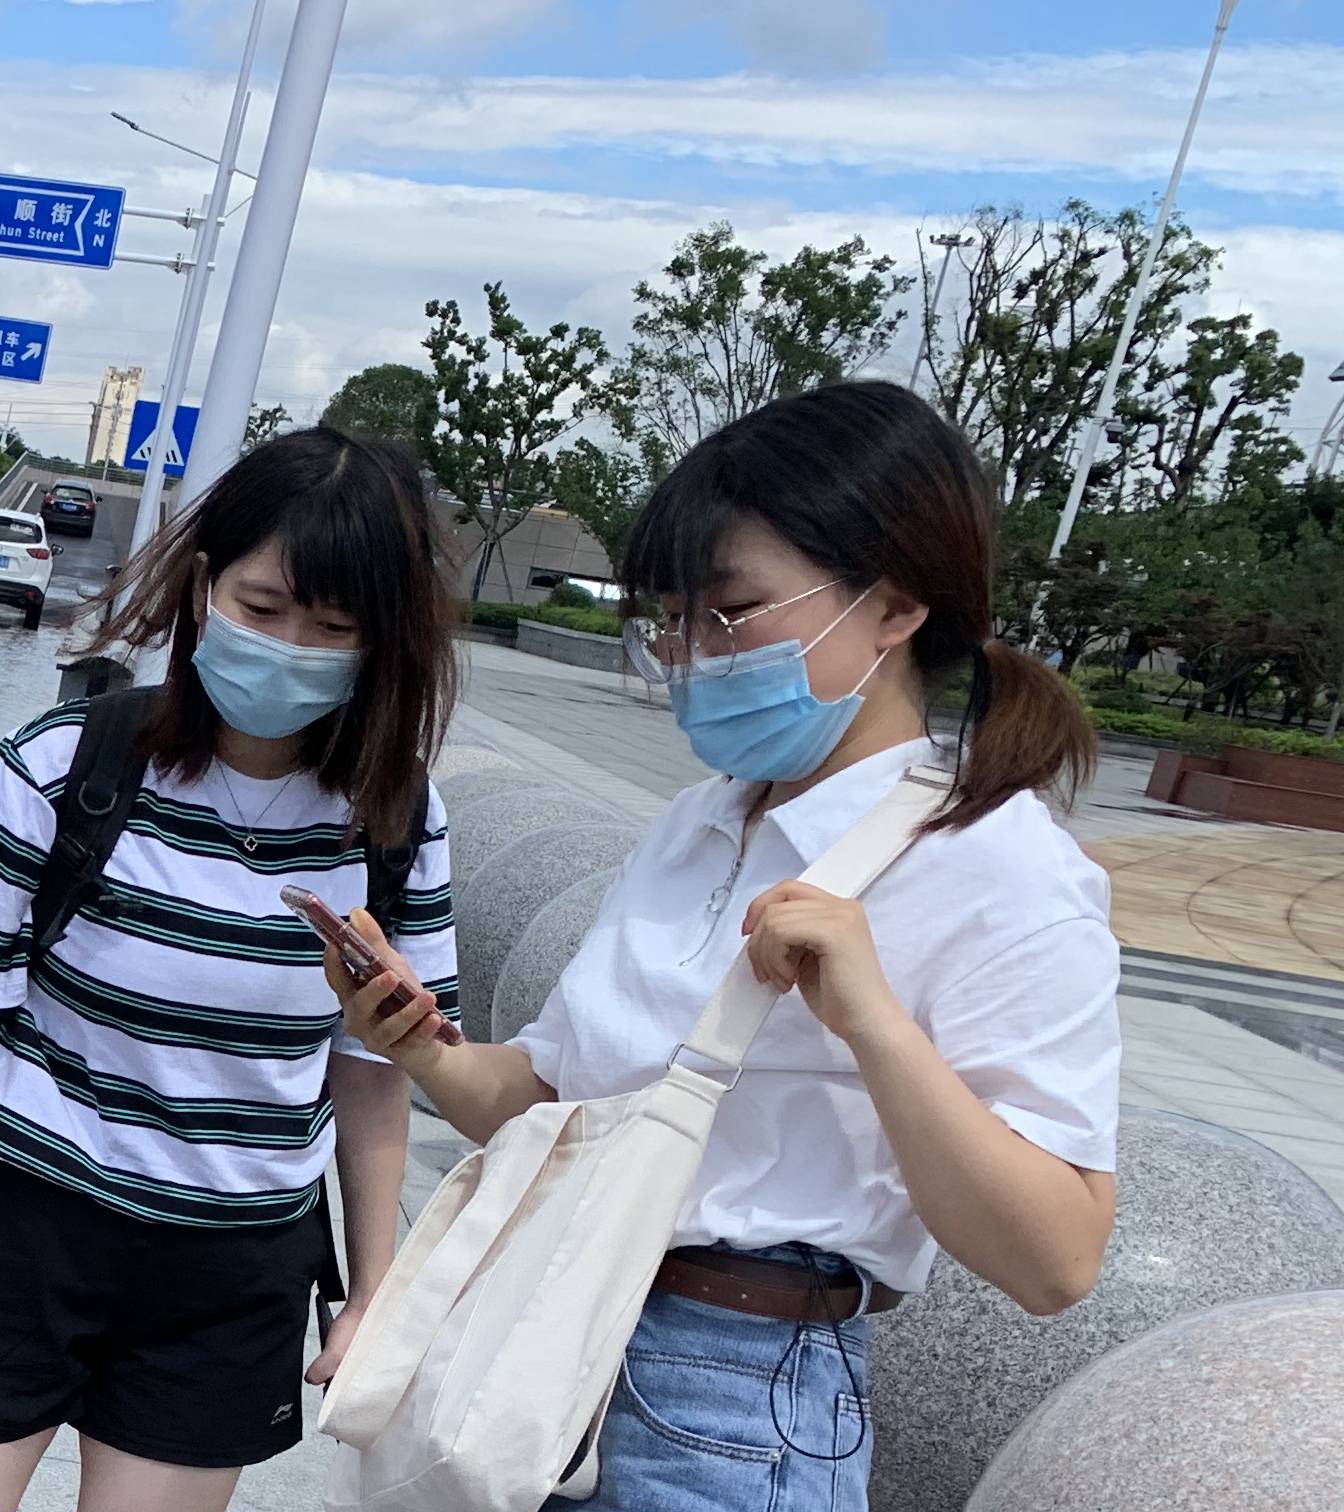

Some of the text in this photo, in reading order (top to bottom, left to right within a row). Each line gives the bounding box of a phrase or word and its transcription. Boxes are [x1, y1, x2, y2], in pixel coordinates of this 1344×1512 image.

[93, 209, 112, 228] 北
[27, 226, 65, 243] Street
[93, 234, 105, 247] N
